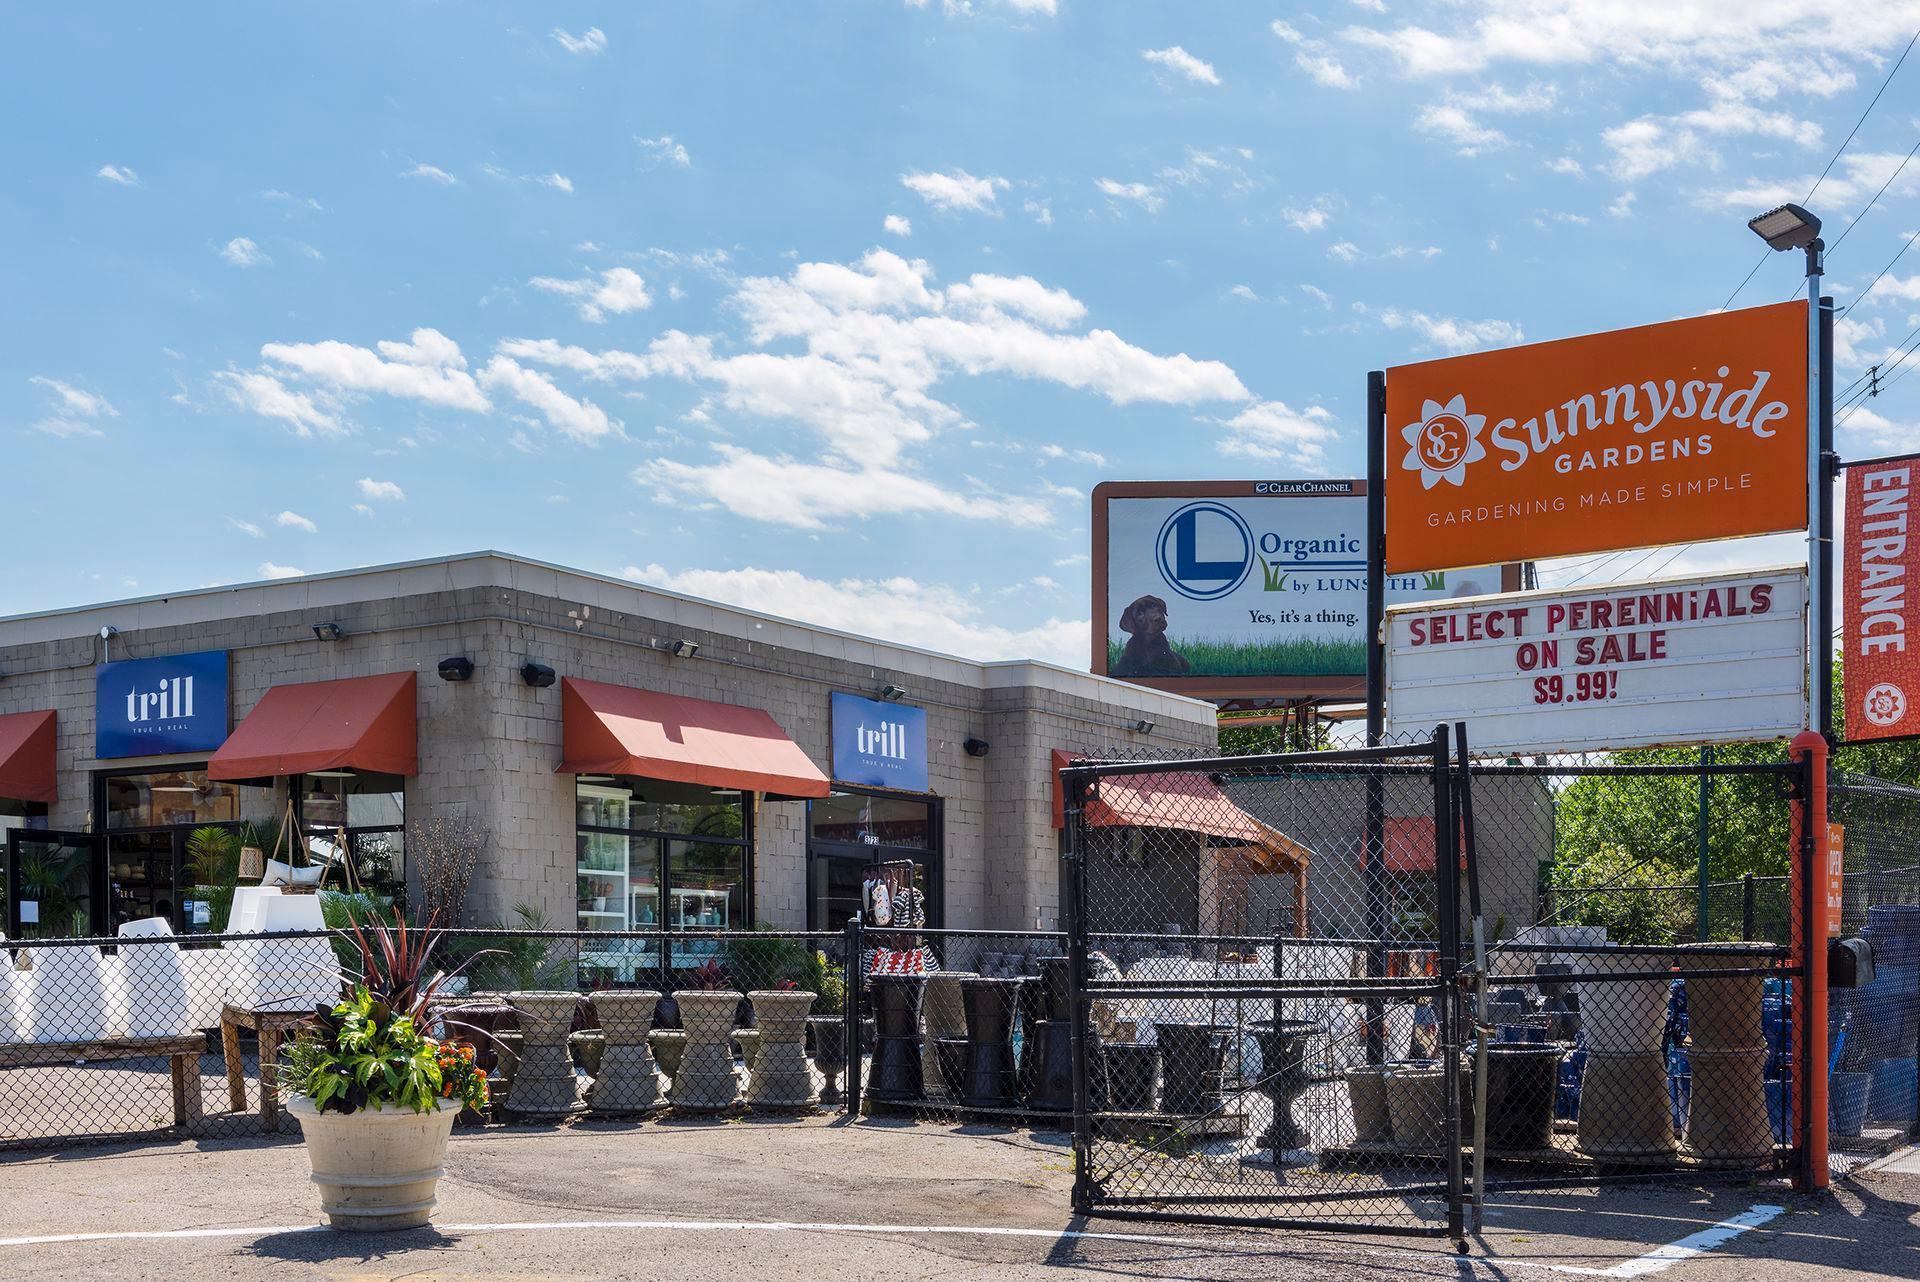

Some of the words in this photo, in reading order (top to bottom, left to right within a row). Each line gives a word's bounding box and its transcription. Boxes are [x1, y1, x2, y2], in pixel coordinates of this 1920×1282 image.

[1491, 365, 1789, 472] Sunnyside
[1554, 434, 1713, 474] GARDENS
[1428, 495, 1566, 527] GARDENING
[1580, 486, 1647, 508] MADE
[1661, 473, 1752, 498] SIMPLE
[1259, 532, 1361, 561] Organic
[1860, 467, 1911, 656] ENTRANCE
[1293, 578, 1310, 594] by
[1316, 577, 1417, 592] LUNSTH
[1248, 609, 1276, 625] Yes,
[1280, 608, 1300, 623] it's
[1304, 613, 1312, 623] a
[1316, 609, 1359, 627] thing.
[1409, 607, 1529, 647] SELECT
[1516, 639, 1558, 671] ON
[1575, 629, 1667, 666] SALE
[125, 675, 196, 722] trill
[1533, 670, 1619, 704] $9.99!
[133, 726, 153, 734] TRUE
[856, 720, 907, 760] trill
